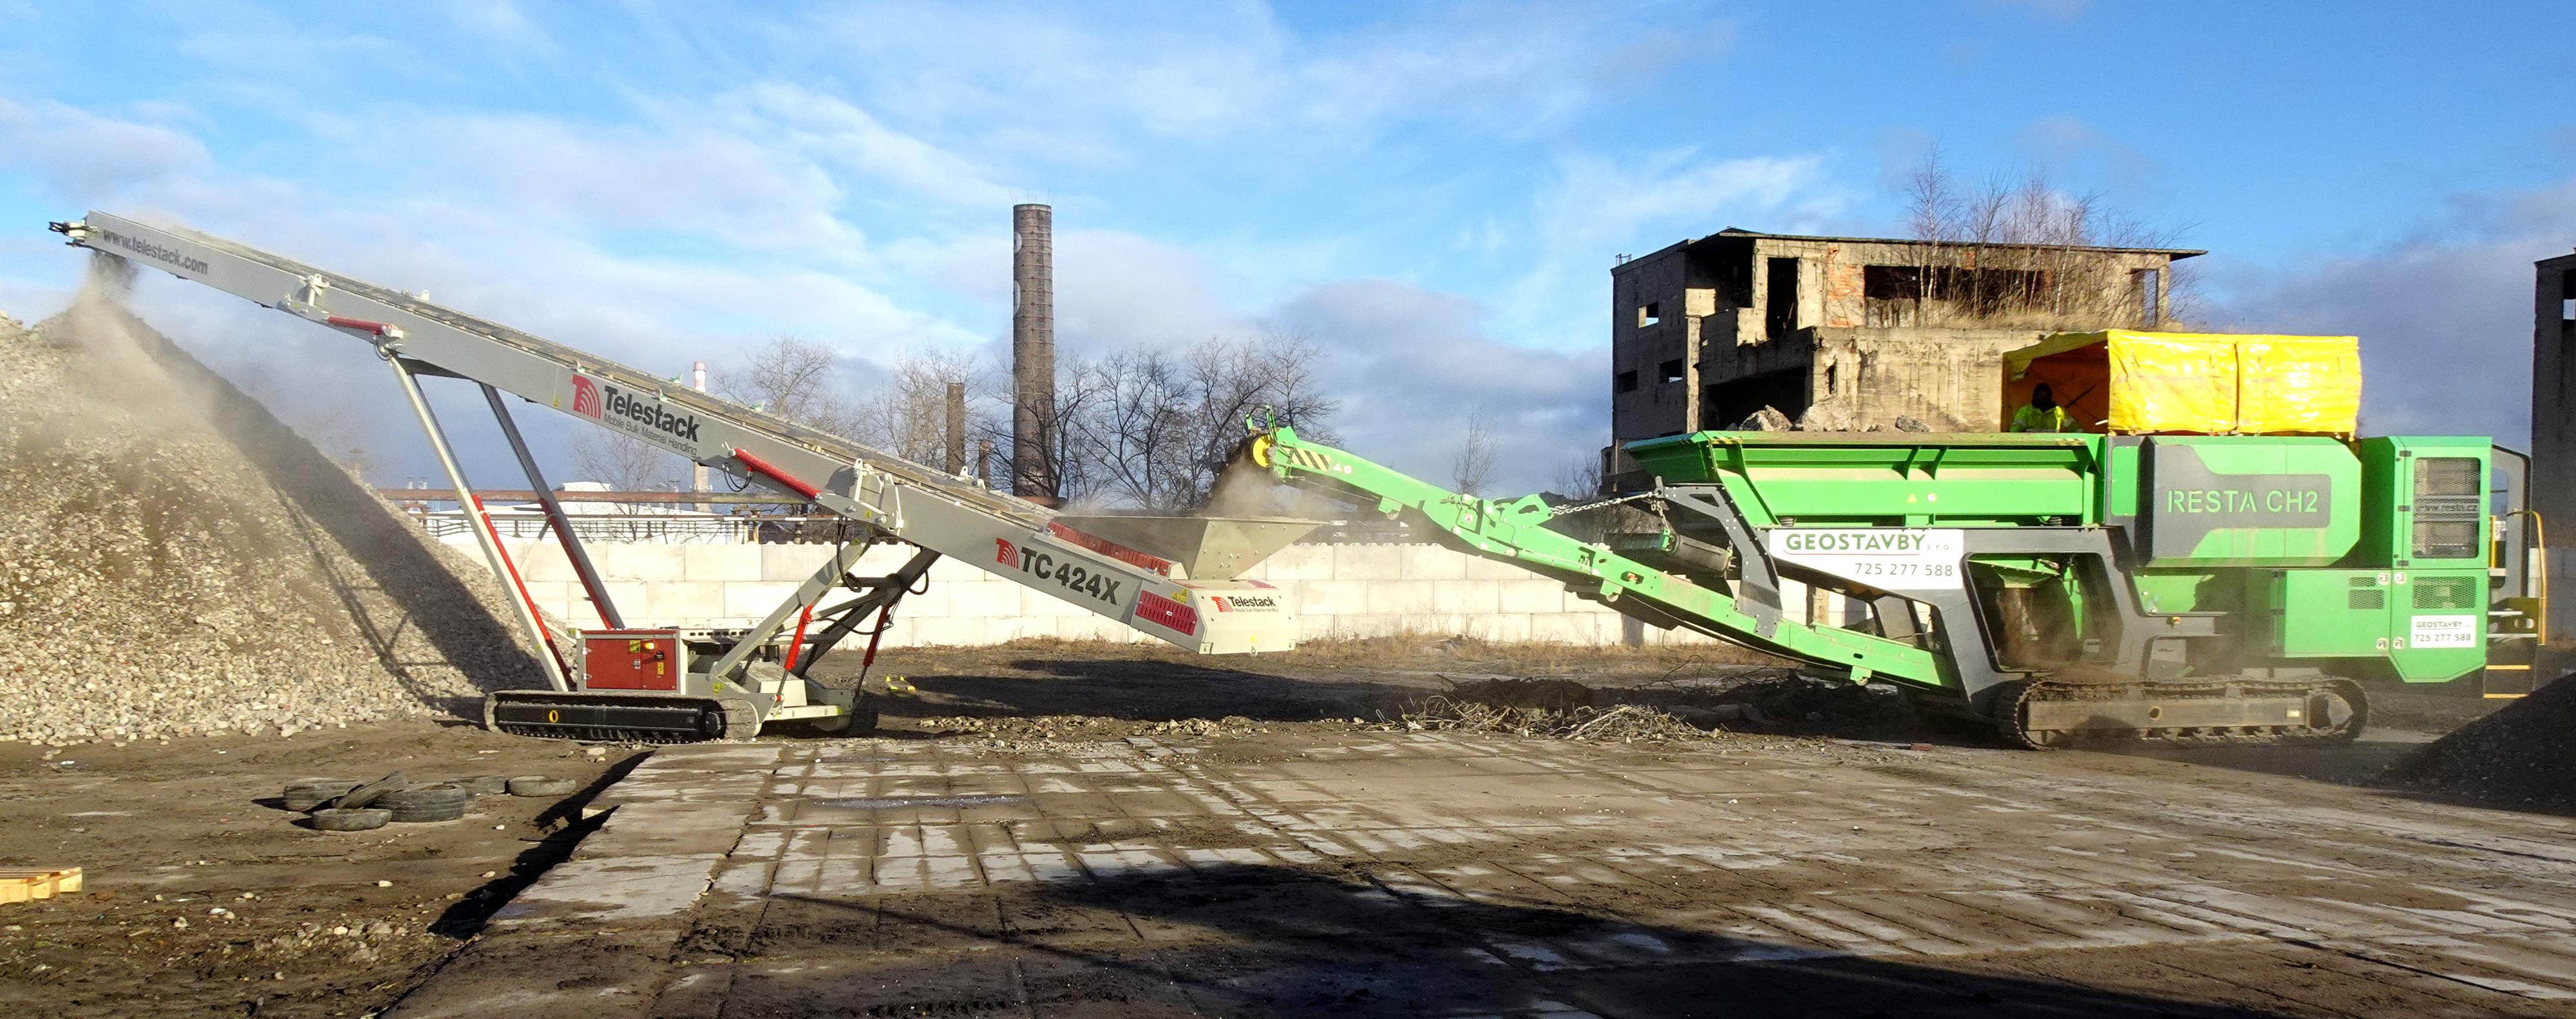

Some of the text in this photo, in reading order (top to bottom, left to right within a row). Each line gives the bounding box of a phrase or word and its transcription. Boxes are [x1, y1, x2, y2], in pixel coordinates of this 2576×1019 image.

[103, 229, 208, 276] www.telestack.com
[604, 385, 701, 443] Telestack
[603, 413, 697, 458] Mobile Bulk Material Handling
[2168, 489, 2318, 513] RESTA CH2
[1786, 533, 1926, 550] GEOSTAVBY
[1854, 563, 1953, 577] 725 277 588
[1227, 596, 1276, 607] Telestack
[2434, 633, 2451, 642] 277
